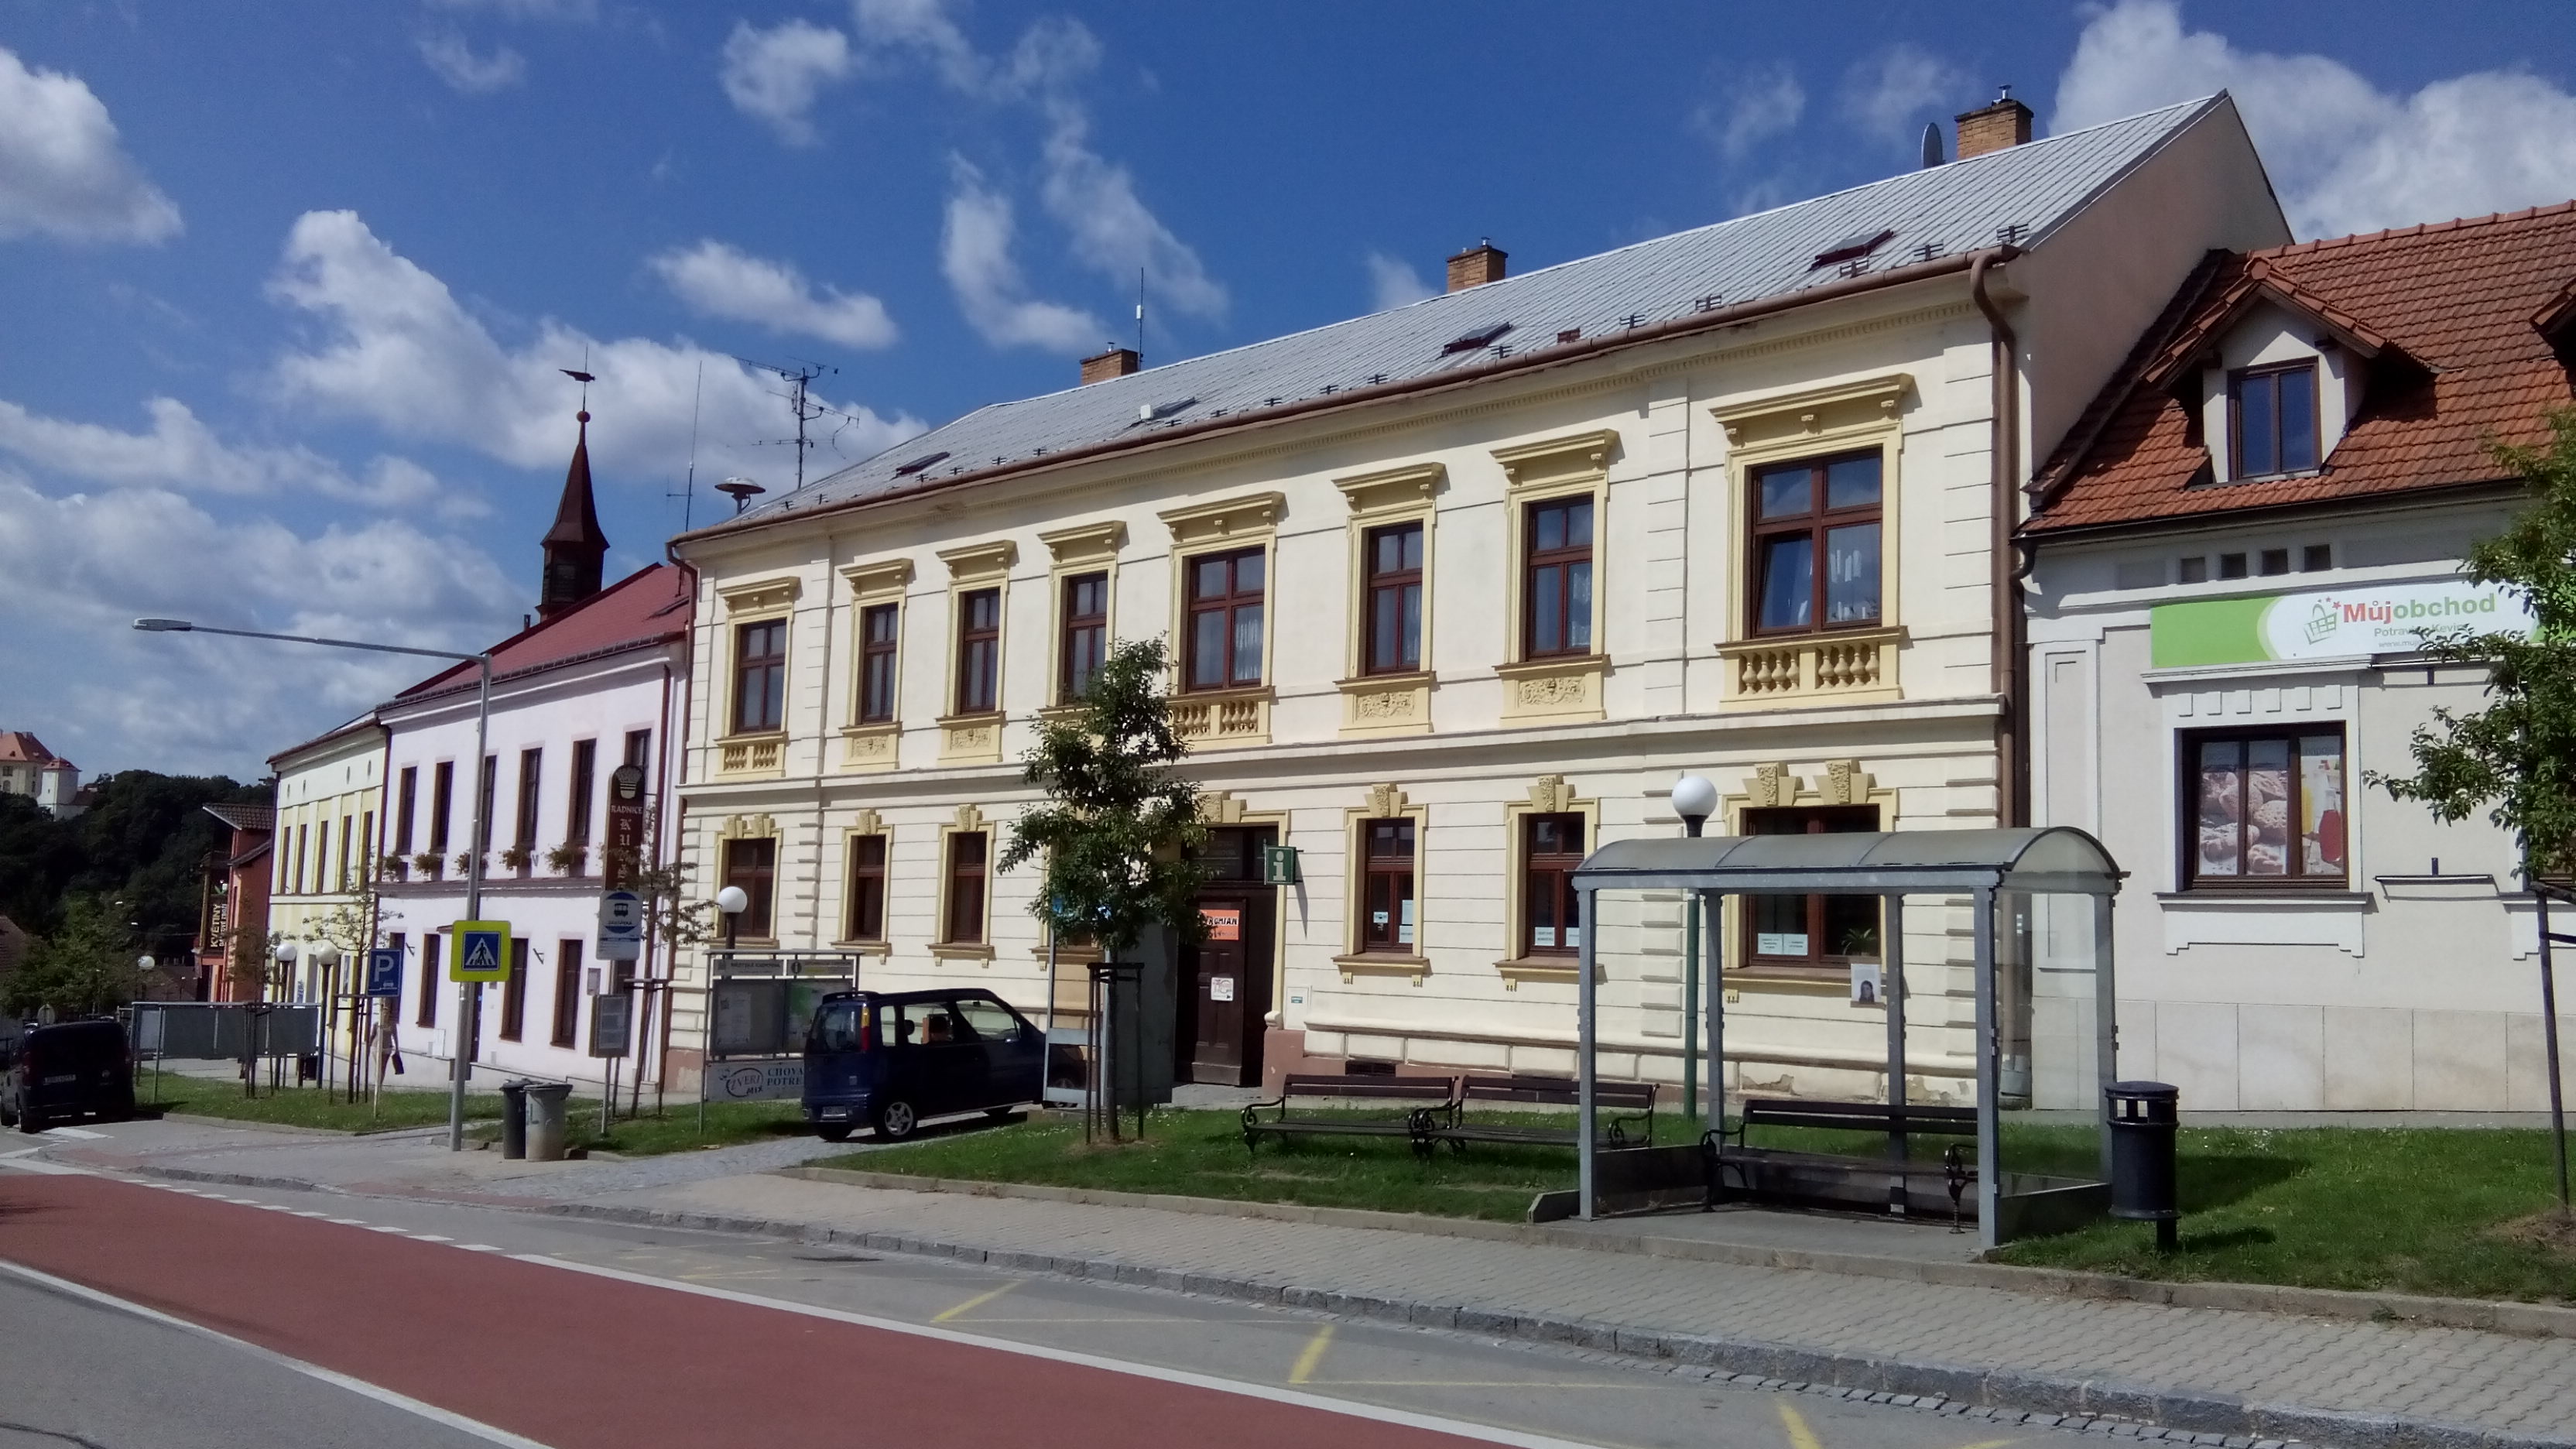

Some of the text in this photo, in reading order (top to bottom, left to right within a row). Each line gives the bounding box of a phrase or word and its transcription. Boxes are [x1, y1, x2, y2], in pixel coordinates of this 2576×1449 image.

[2343, 593, 2496, 624] Můjobchod
[2374, 625, 2428, 638] Potrav
[610, 805, 643, 814] RADNICE
[374, 955, 394, 982] P
